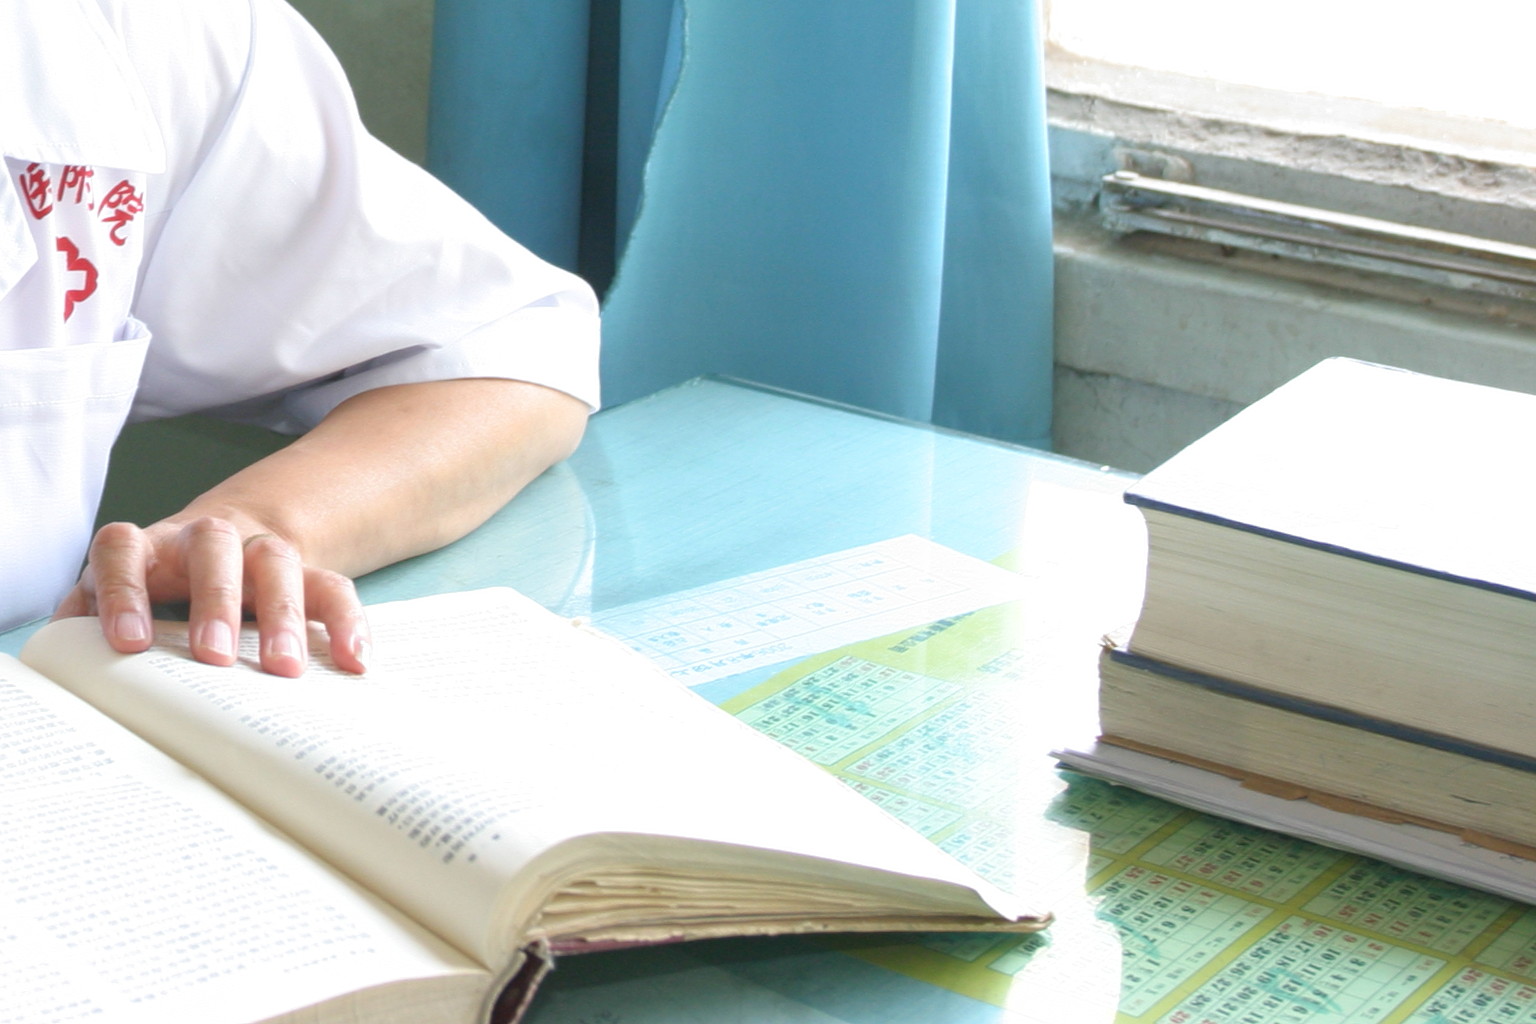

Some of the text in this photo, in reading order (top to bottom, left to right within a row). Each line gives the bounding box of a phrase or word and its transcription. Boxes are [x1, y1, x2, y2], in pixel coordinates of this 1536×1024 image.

[822, 700, 840, 710] 15
[802, 712, 820, 721] 16
[783, 723, 799, 732] 17
[1241, 857, 1261, 869] 12
[1105, 881, 1125, 893] 26
[1173, 882, 1192, 892] 11
[1130, 889, 1149, 900] 19
[1153, 897, 1173, 908] 12
[1382, 899, 1400, 913] 17
[1110, 903, 1130, 915] 20
[1133, 911, 1154, 923] 13
[1390, 921, 1409, 932] 11
[1142, 936, 1157, 944] 7
[1343, 935, 1358, 943] 9
[1368, 943, 1383, 951] 2
[1321, 949, 1340, 961] 10
[1349, 958, 1366, 967] 3
[1216, 925, 1333, 1016] 16 17 18 19 20 21
[1301, 963, 1322, 976] 11
[1125, 975, 1141, 983] 2
[1170, 932, 1290, 1024] 24 25 26 27 28 29
[1282, 980, 1303, 992] 12
[1445, 985, 1465, 999] 27
[1263, 996, 1283, 1009] 13
[1453, 978, 1509, 1023] 19 20 21
[1292, 1006, 1307, 1014] 6
[1500, 1002, 1521, 1016] 13
